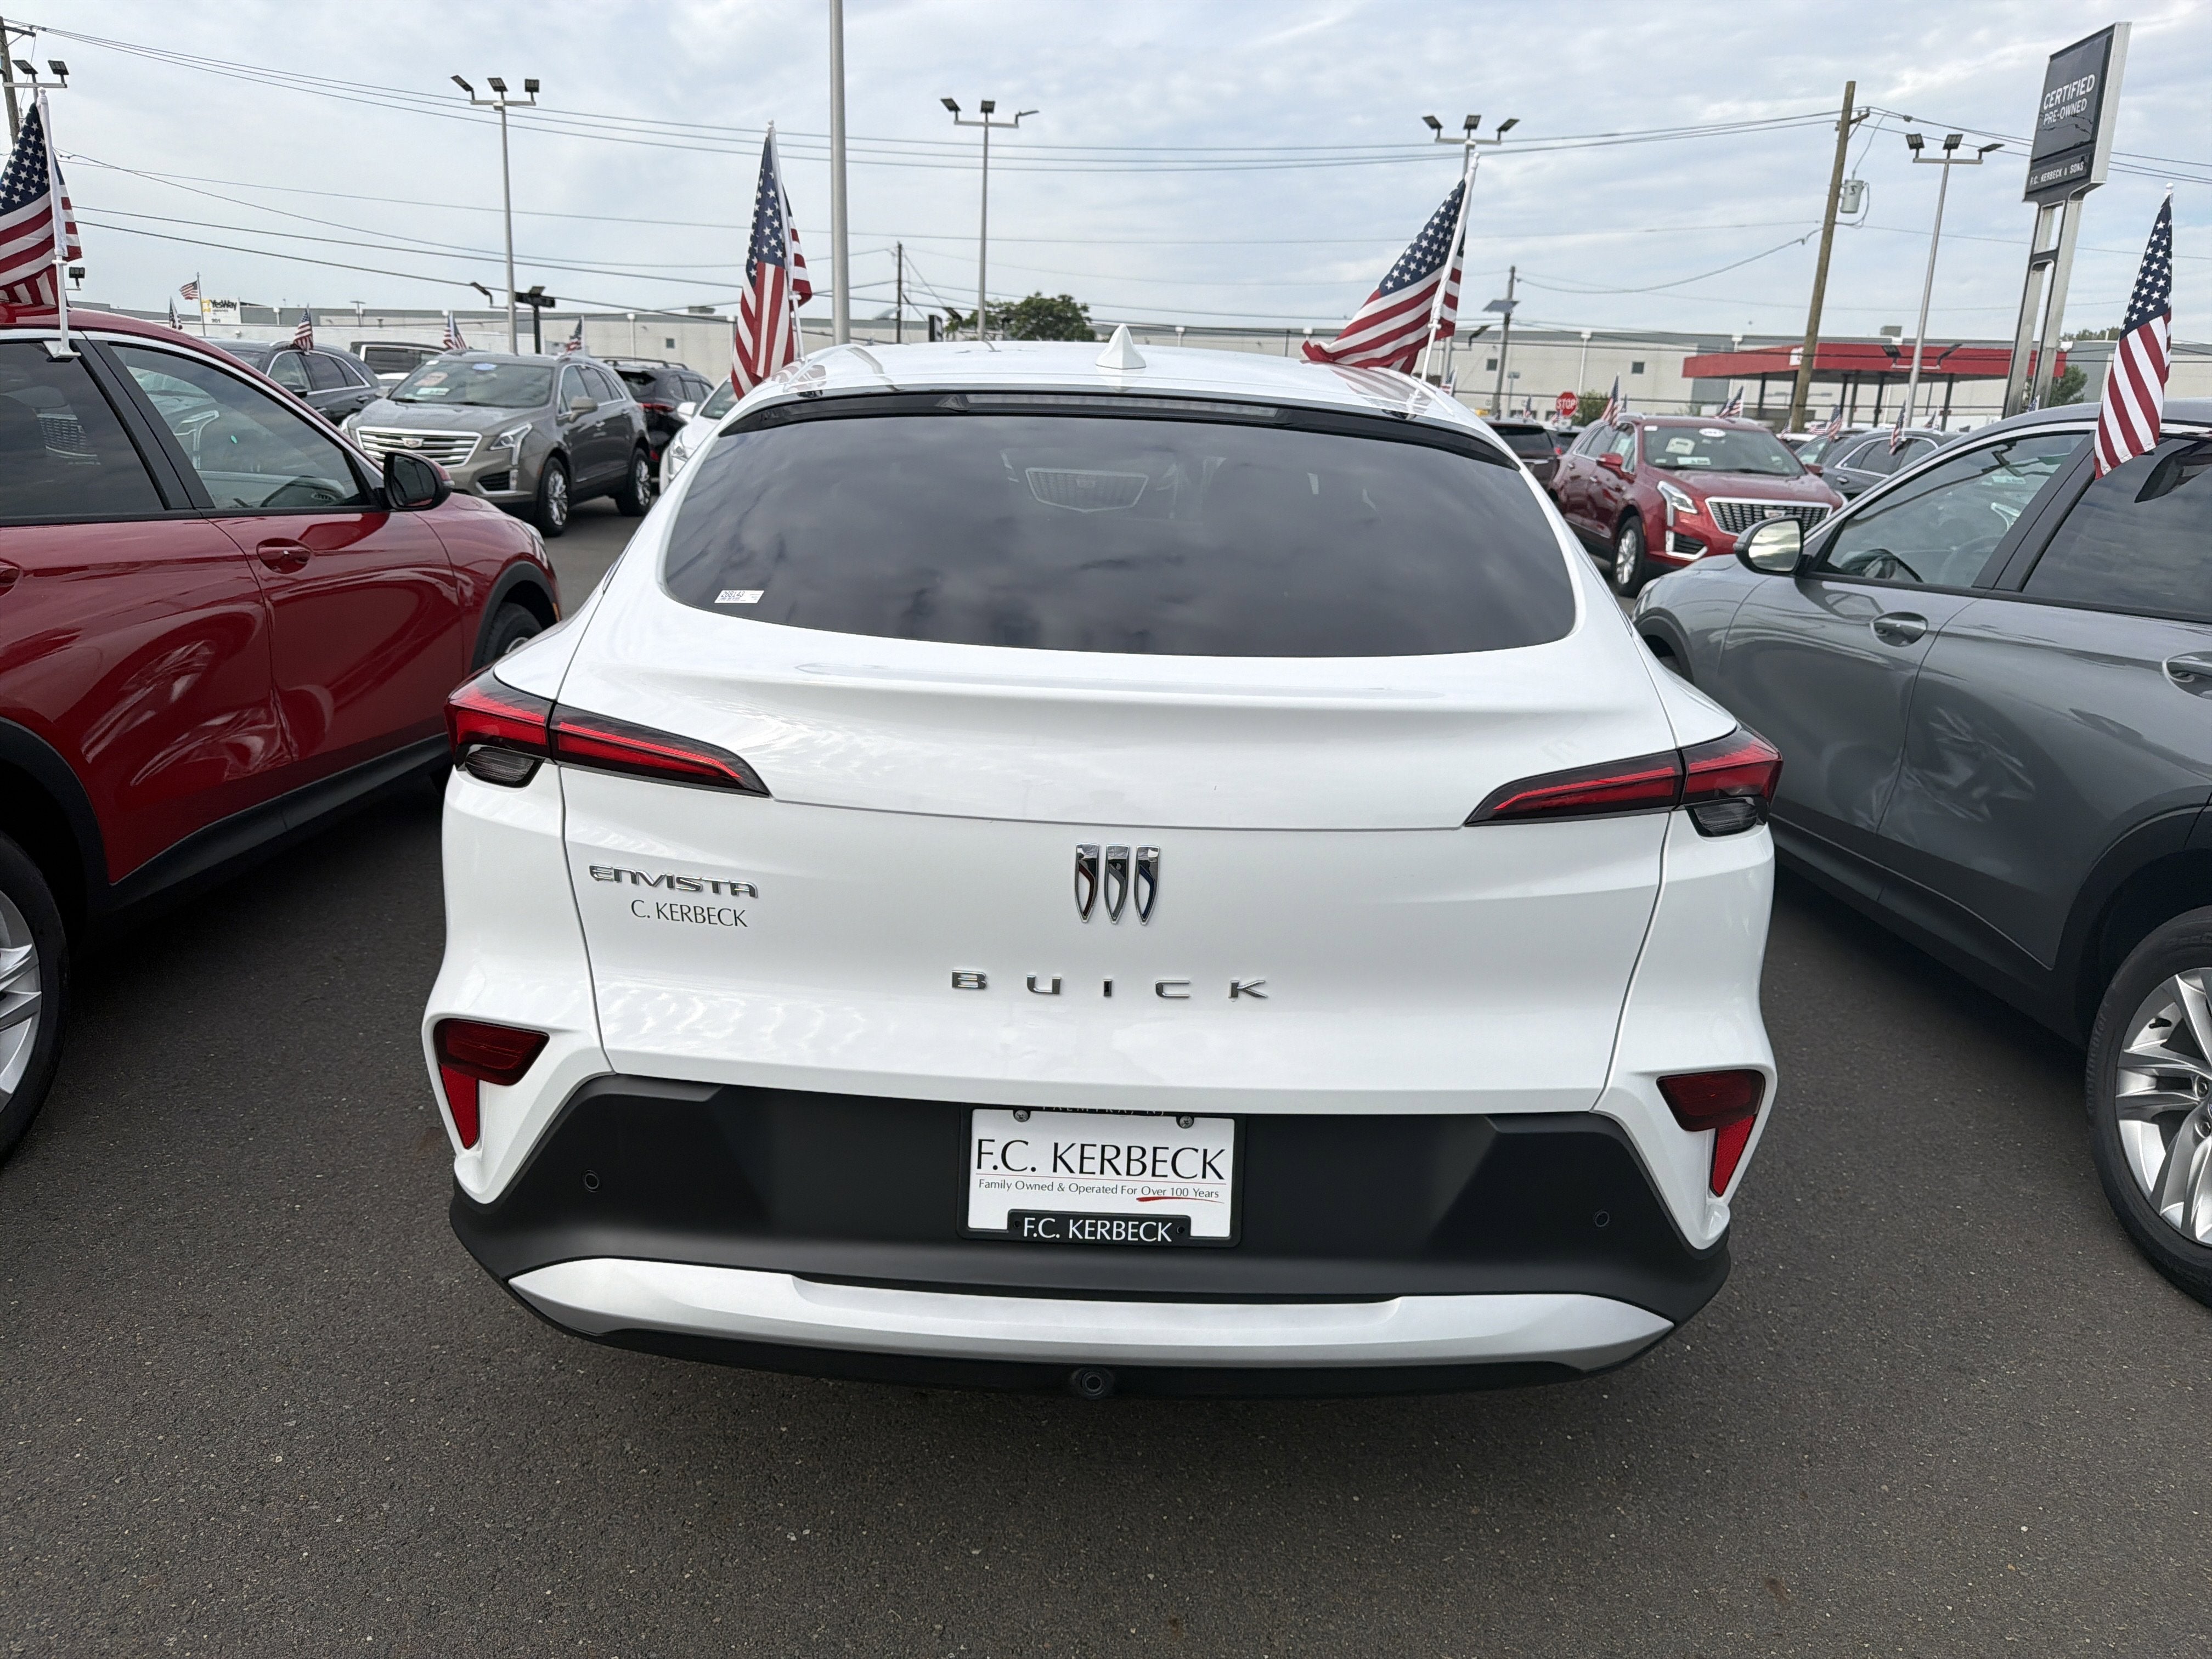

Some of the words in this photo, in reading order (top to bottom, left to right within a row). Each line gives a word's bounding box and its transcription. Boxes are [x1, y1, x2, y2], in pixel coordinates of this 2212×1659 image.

[2044, 74, 2095, 110] CERTIFIED
[2044, 98, 2087, 126] PRE-OWNED
[1556, 398, 1576, 410] STOP
[589, 864, 759, 898] ENVISTA
[631, 900, 651, 918] C.
[656, 902, 748, 927] KERBECK
[951, 969, 1268, 1000] BUICK
[977, 1138, 1036, 1172] F.C.
[1052, 1142, 1226, 1180] KERBECK
[979, 1179, 1012, 1192] Family
[1015, 1181, 1054, 1191] Owned
[1057, 1183, 1065, 1192] &
[1069, 1183, 1118, 1195] Operated
[1121, 1186, 1137, 1195] For
[1141, 1186, 1166, 1197] Over
[1170, 1187, 1189, 1197] 100
[1193, 1188, 1219, 1198] Years
[1023, 1217, 1060, 1238] F.C.
[1068, 1219, 1172, 1242] KERBECK
